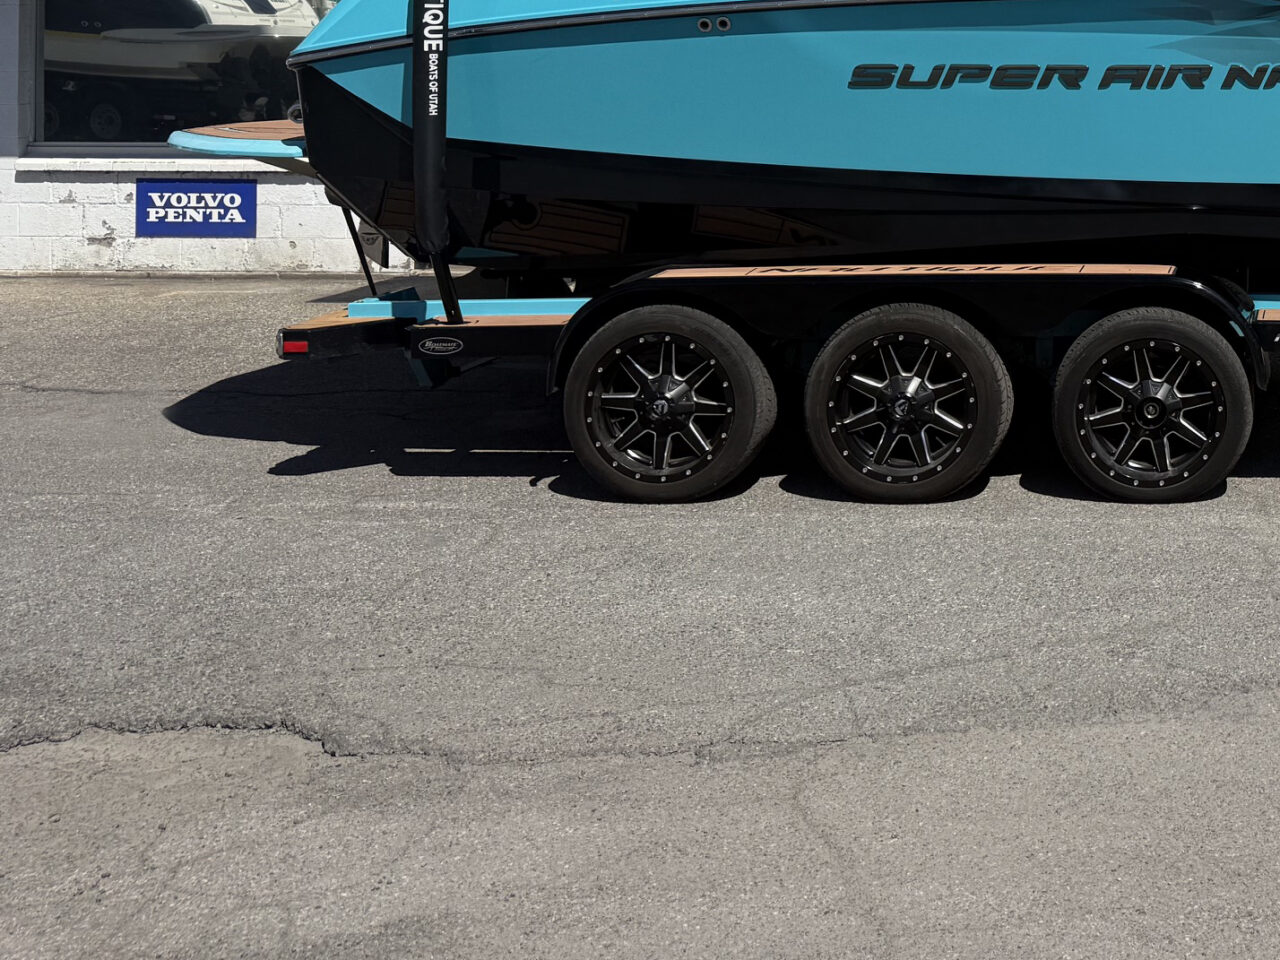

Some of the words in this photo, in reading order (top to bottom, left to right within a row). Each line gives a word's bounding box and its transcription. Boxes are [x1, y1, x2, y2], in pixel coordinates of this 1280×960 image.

[429, 53, 439, 80] BOATS
[848, 63, 1090, 90] SUPER
[1098, 64, 1214, 91] AIR
[429, 81, 439, 93] OF
[428, 93, 438, 116] UTAH
[148, 192, 242, 208] VOLVO
[146, 208, 246, 223] PENTA
